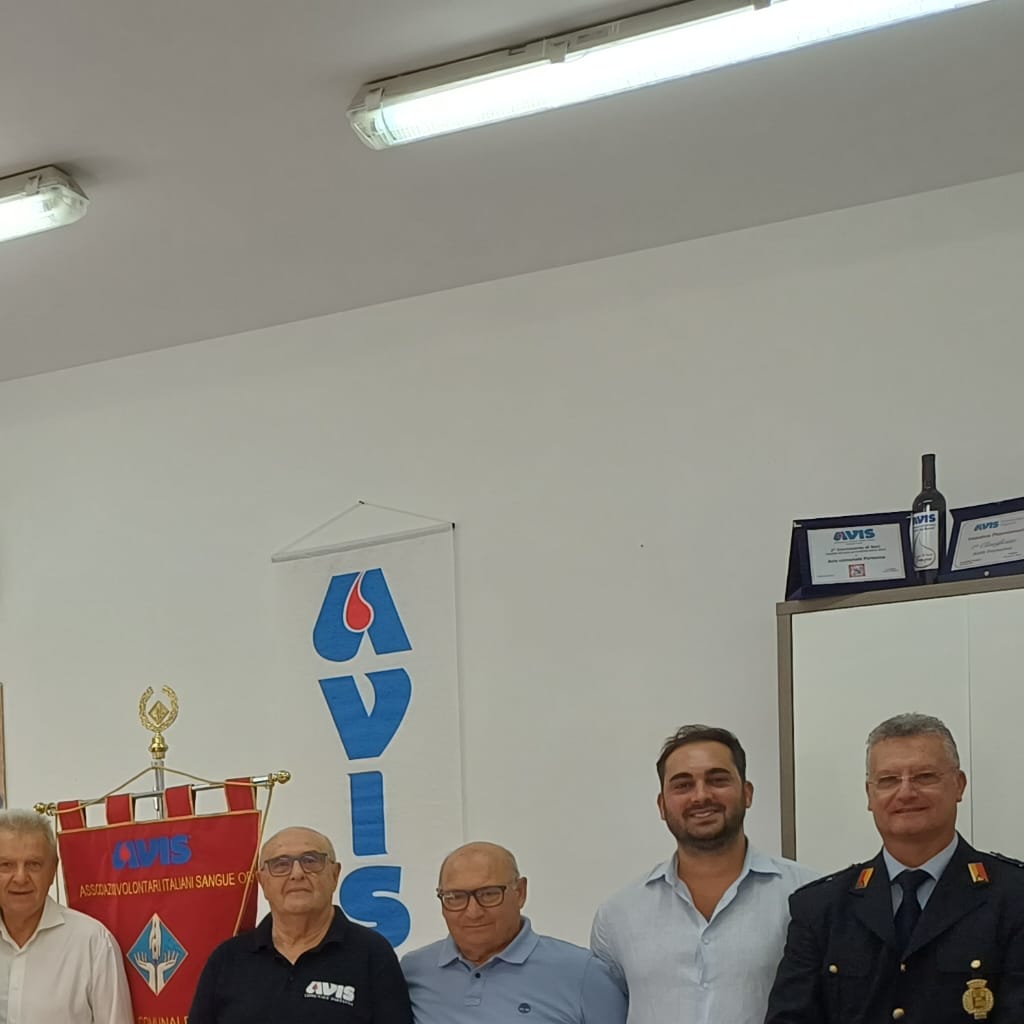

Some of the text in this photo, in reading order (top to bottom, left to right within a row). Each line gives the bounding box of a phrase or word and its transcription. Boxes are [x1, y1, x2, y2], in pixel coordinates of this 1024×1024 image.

[833, 528, 876, 541] AVIS
[974, 521, 999, 531] AVIS
[313, 567, 413, 949] AVIS
[113, 834, 192, 870] AVIS
[195, 872, 236, 888] SANGUE
[306, 981, 355, 1001] AVIS
